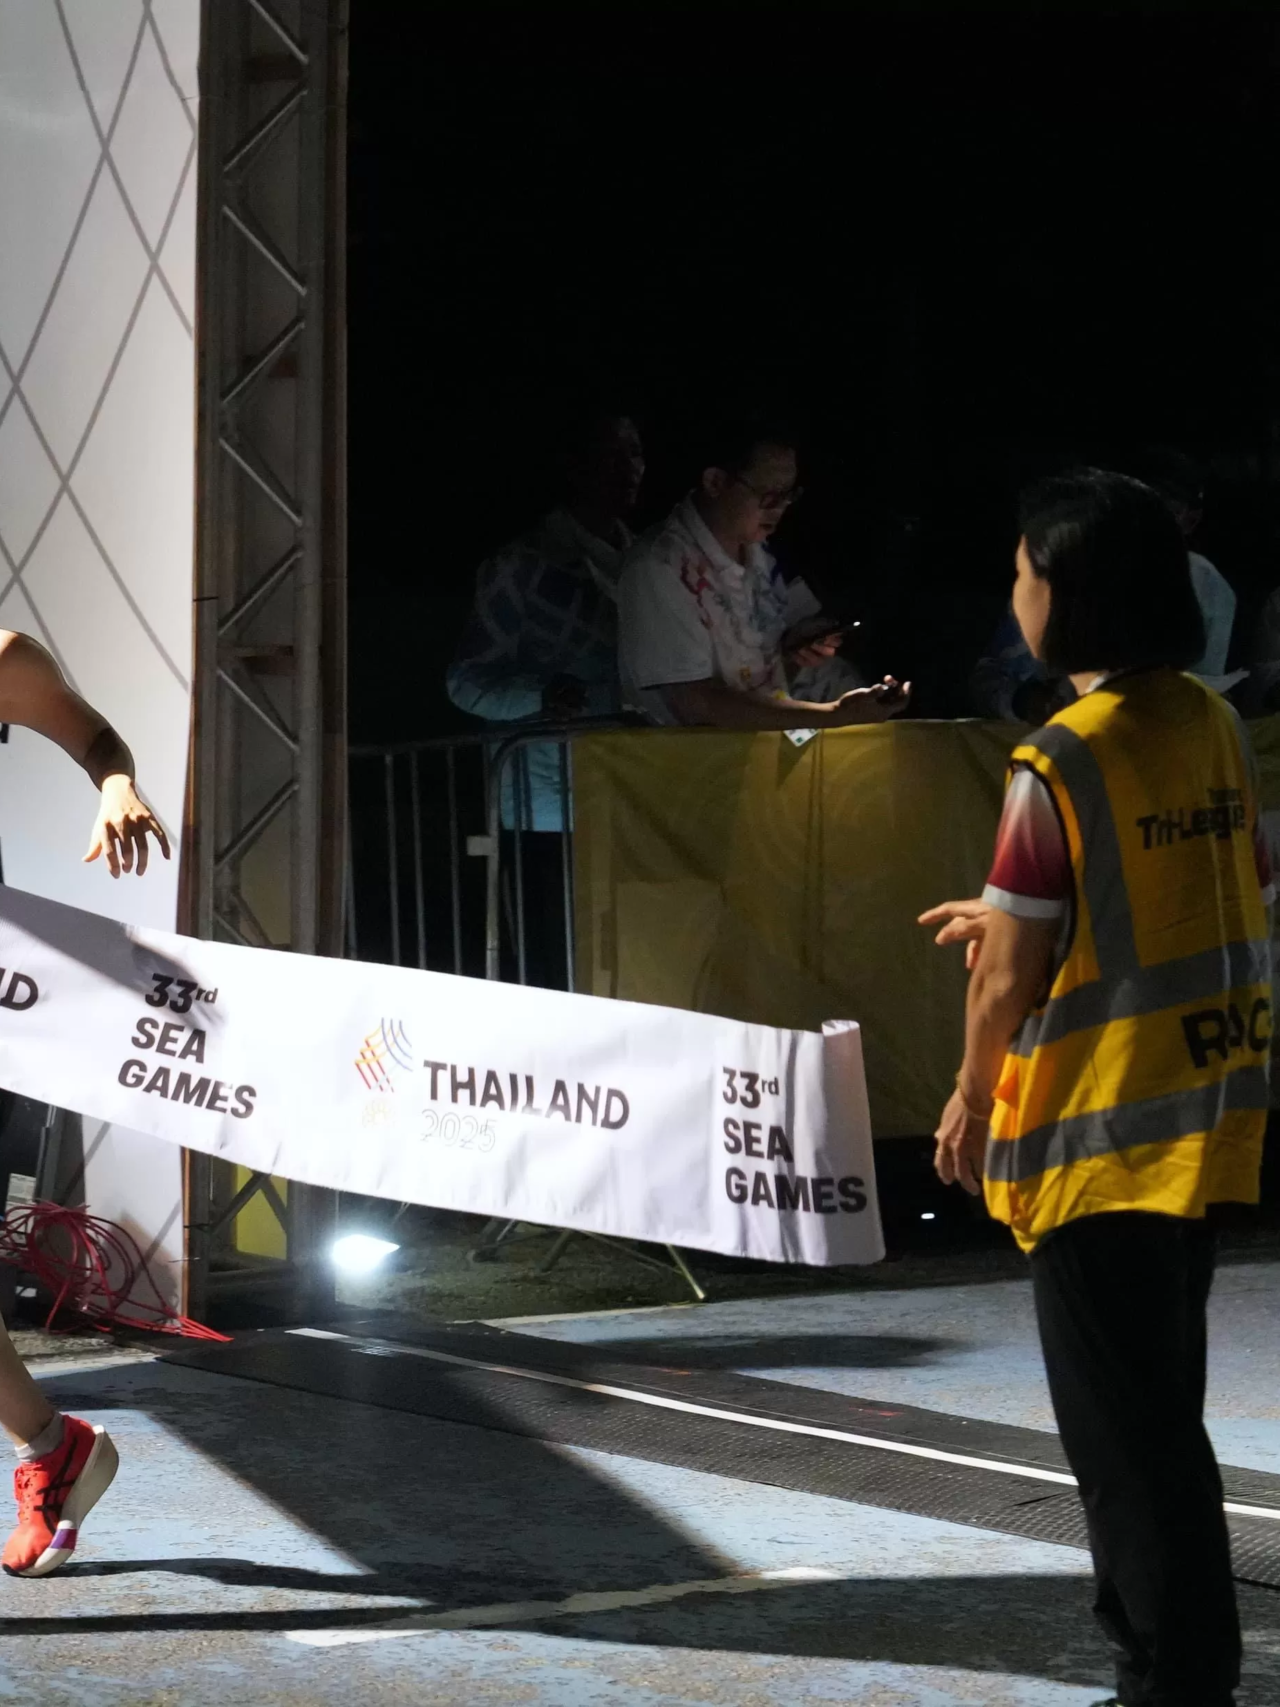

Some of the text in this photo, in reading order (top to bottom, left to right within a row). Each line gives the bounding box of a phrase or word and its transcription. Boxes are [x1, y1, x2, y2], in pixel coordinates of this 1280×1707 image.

[144, 972, 218, 1014] 33rd
[130, 1017, 207, 1064] SEA
[117, 1058, 257, 1119] GAMES
[423, 1060, 630, 1130] THAILAND
[723, 1066, 780, 1109] 33rd
[421, 1109, 497, 1153] 2025
[723, 1121, 795, 1163] SEA
[725, 1167, 868, 1214] GAMES
